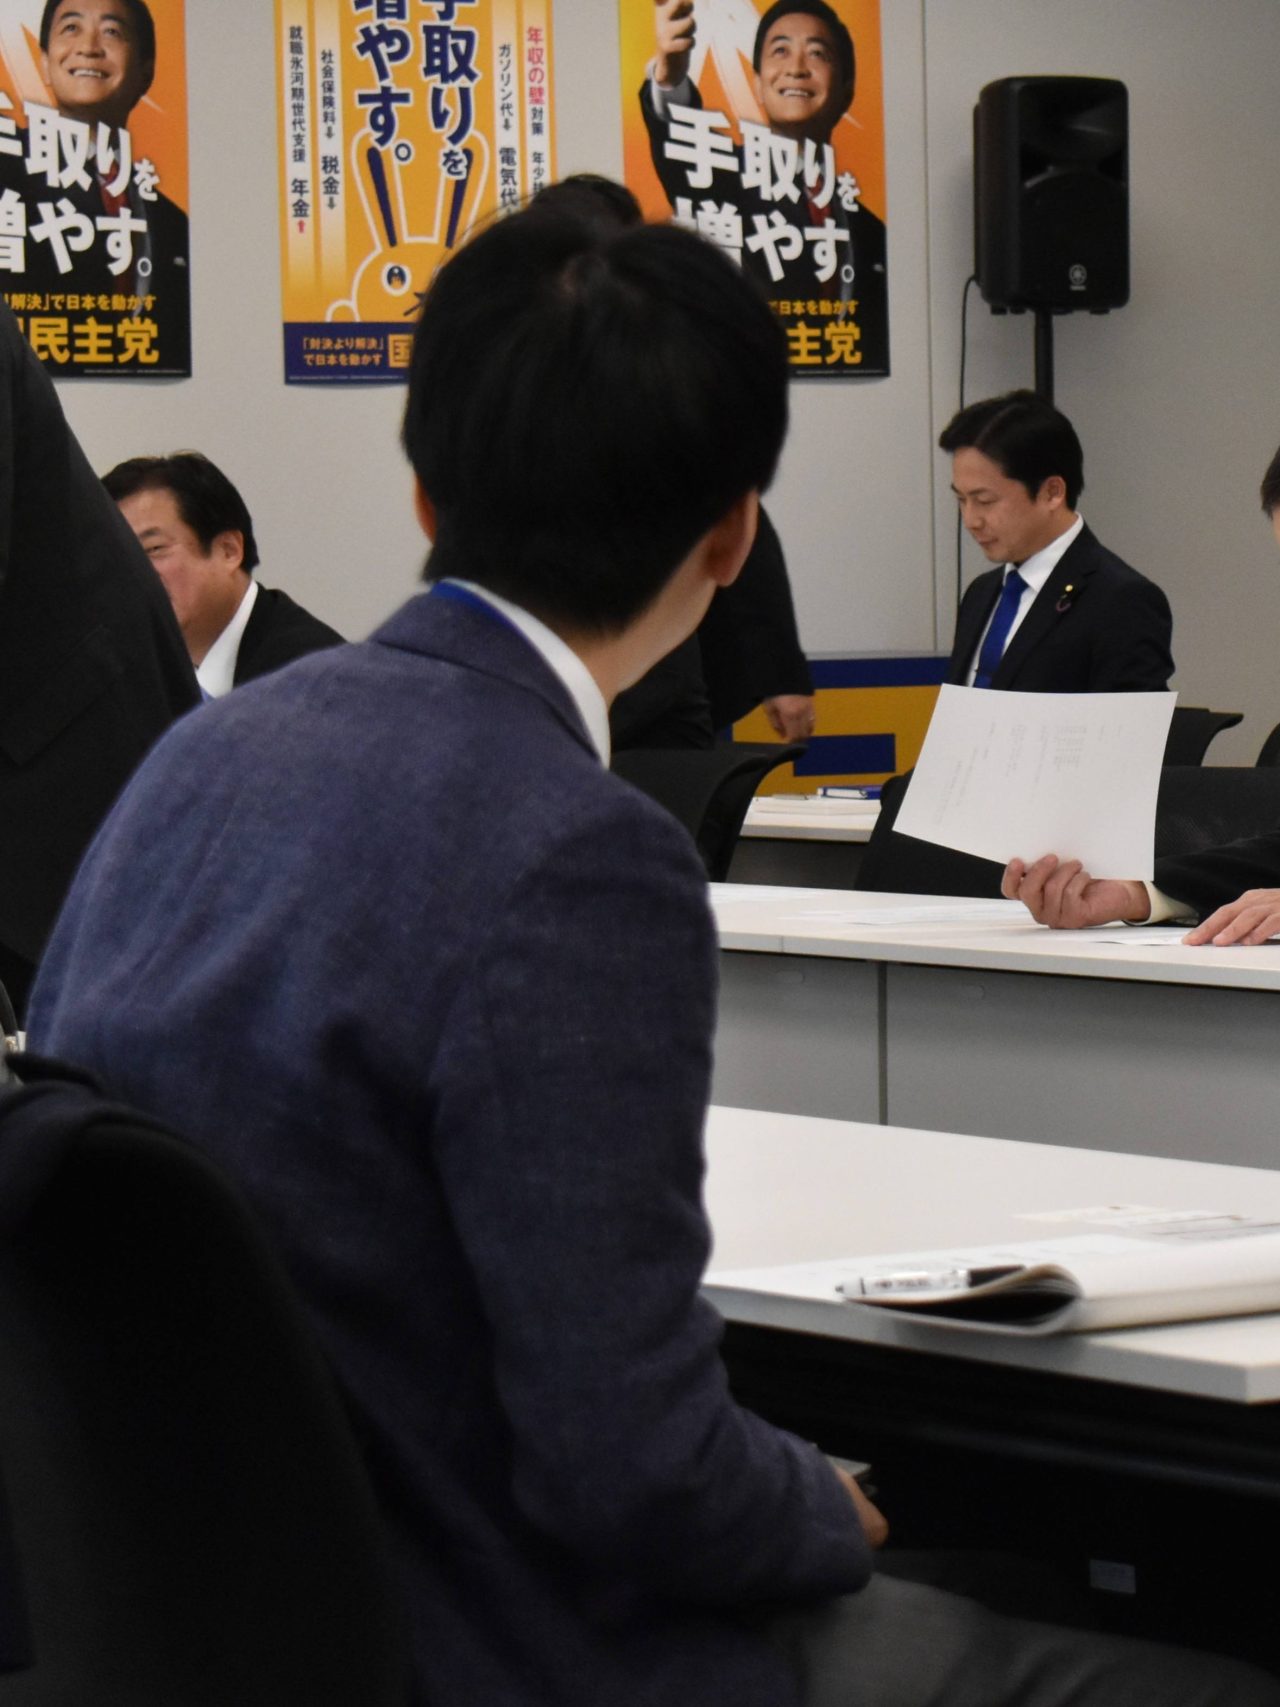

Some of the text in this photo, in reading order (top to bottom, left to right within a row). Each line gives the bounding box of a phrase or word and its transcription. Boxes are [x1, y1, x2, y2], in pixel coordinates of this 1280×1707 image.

[320, 49, 341, 197] 社会保険料 税金
[498, 147, 519, 208] 電気代
[664, 103, 861, 212] 手取りを
[291, 178, 311, 219] 年金
[17, 315, 160, 364] 民主党
